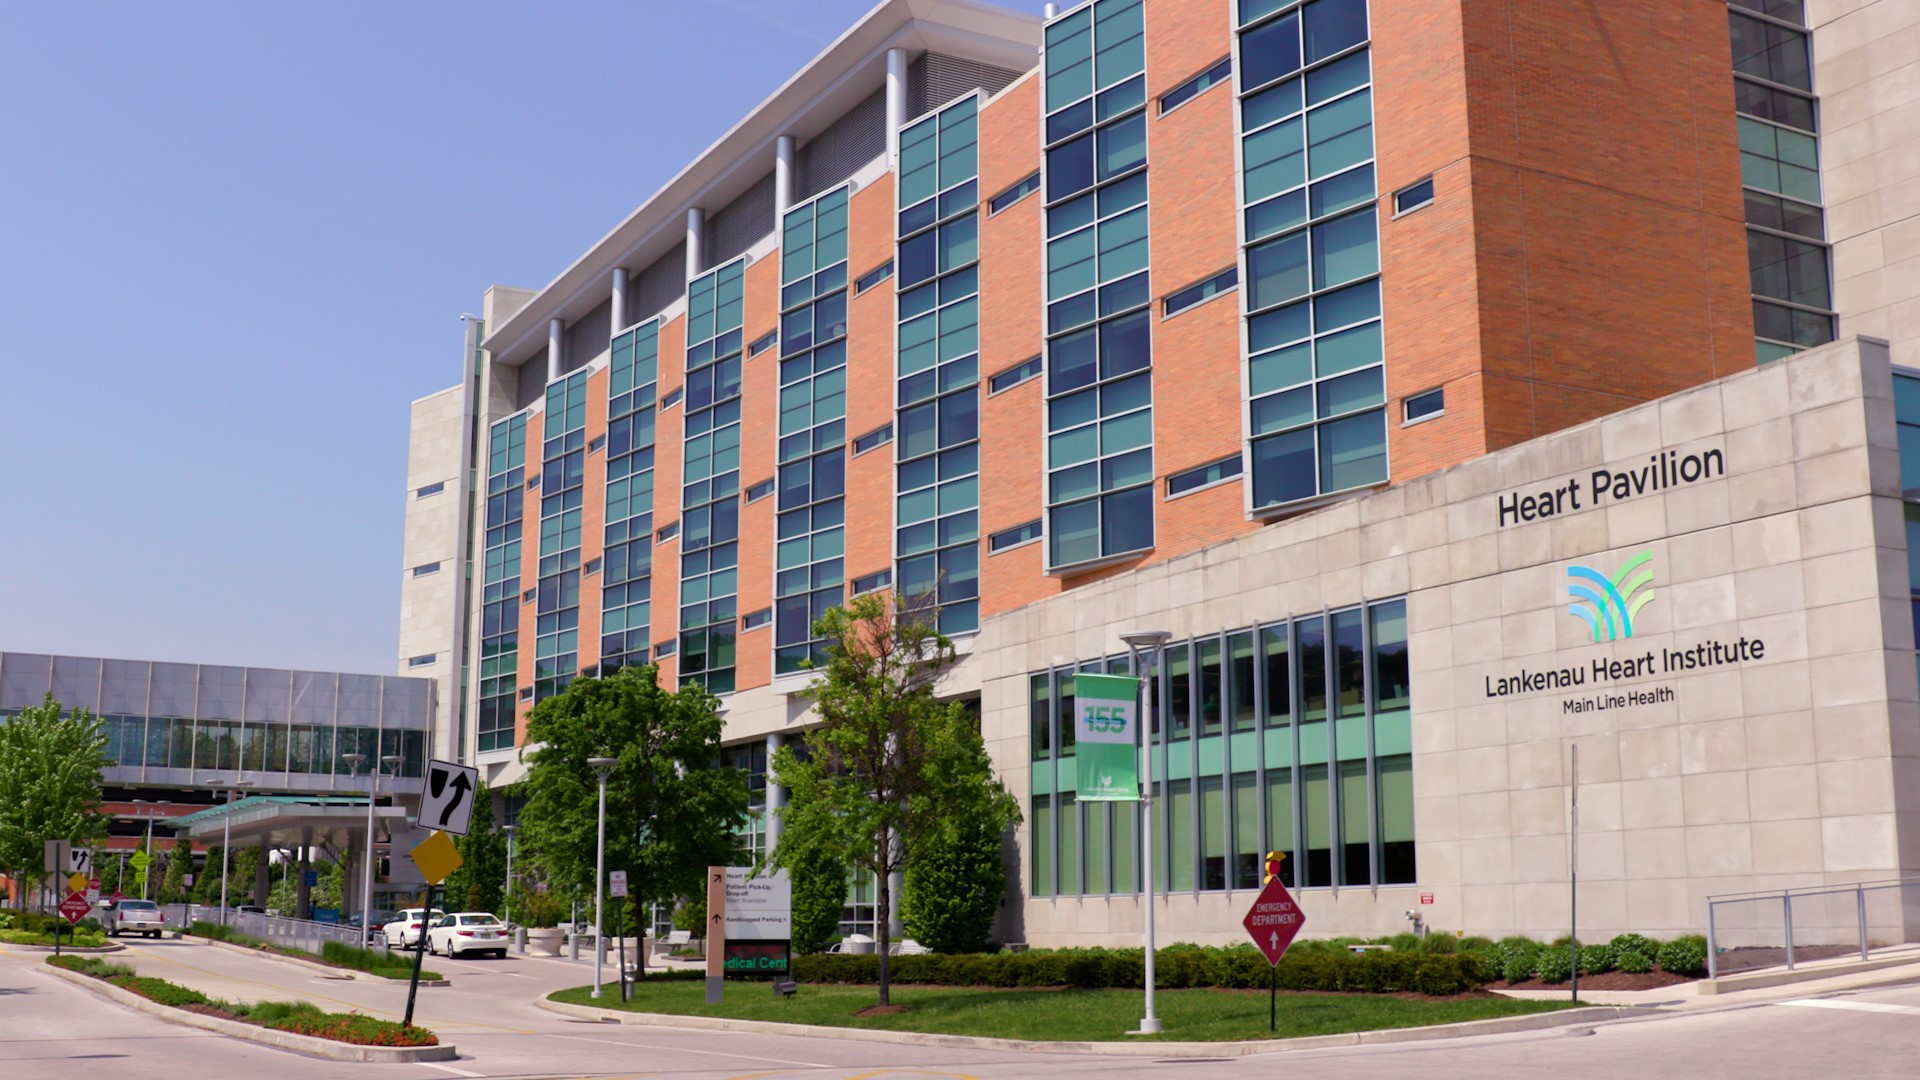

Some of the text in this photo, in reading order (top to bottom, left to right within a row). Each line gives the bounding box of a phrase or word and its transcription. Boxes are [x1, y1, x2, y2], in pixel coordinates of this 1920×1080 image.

[1499, 448, 1724, 527] Heart Pavilion
[1486, 636, 1765, 698] Lankenau Heart Institute
[1563, 686, 1675, 715] Main Line Health
[1084, 706, 1126, 733] 155
[1252, 914, 1296, 926] DEPARTMENT
[1256, 903, 1292, 912] EMERGENCY
